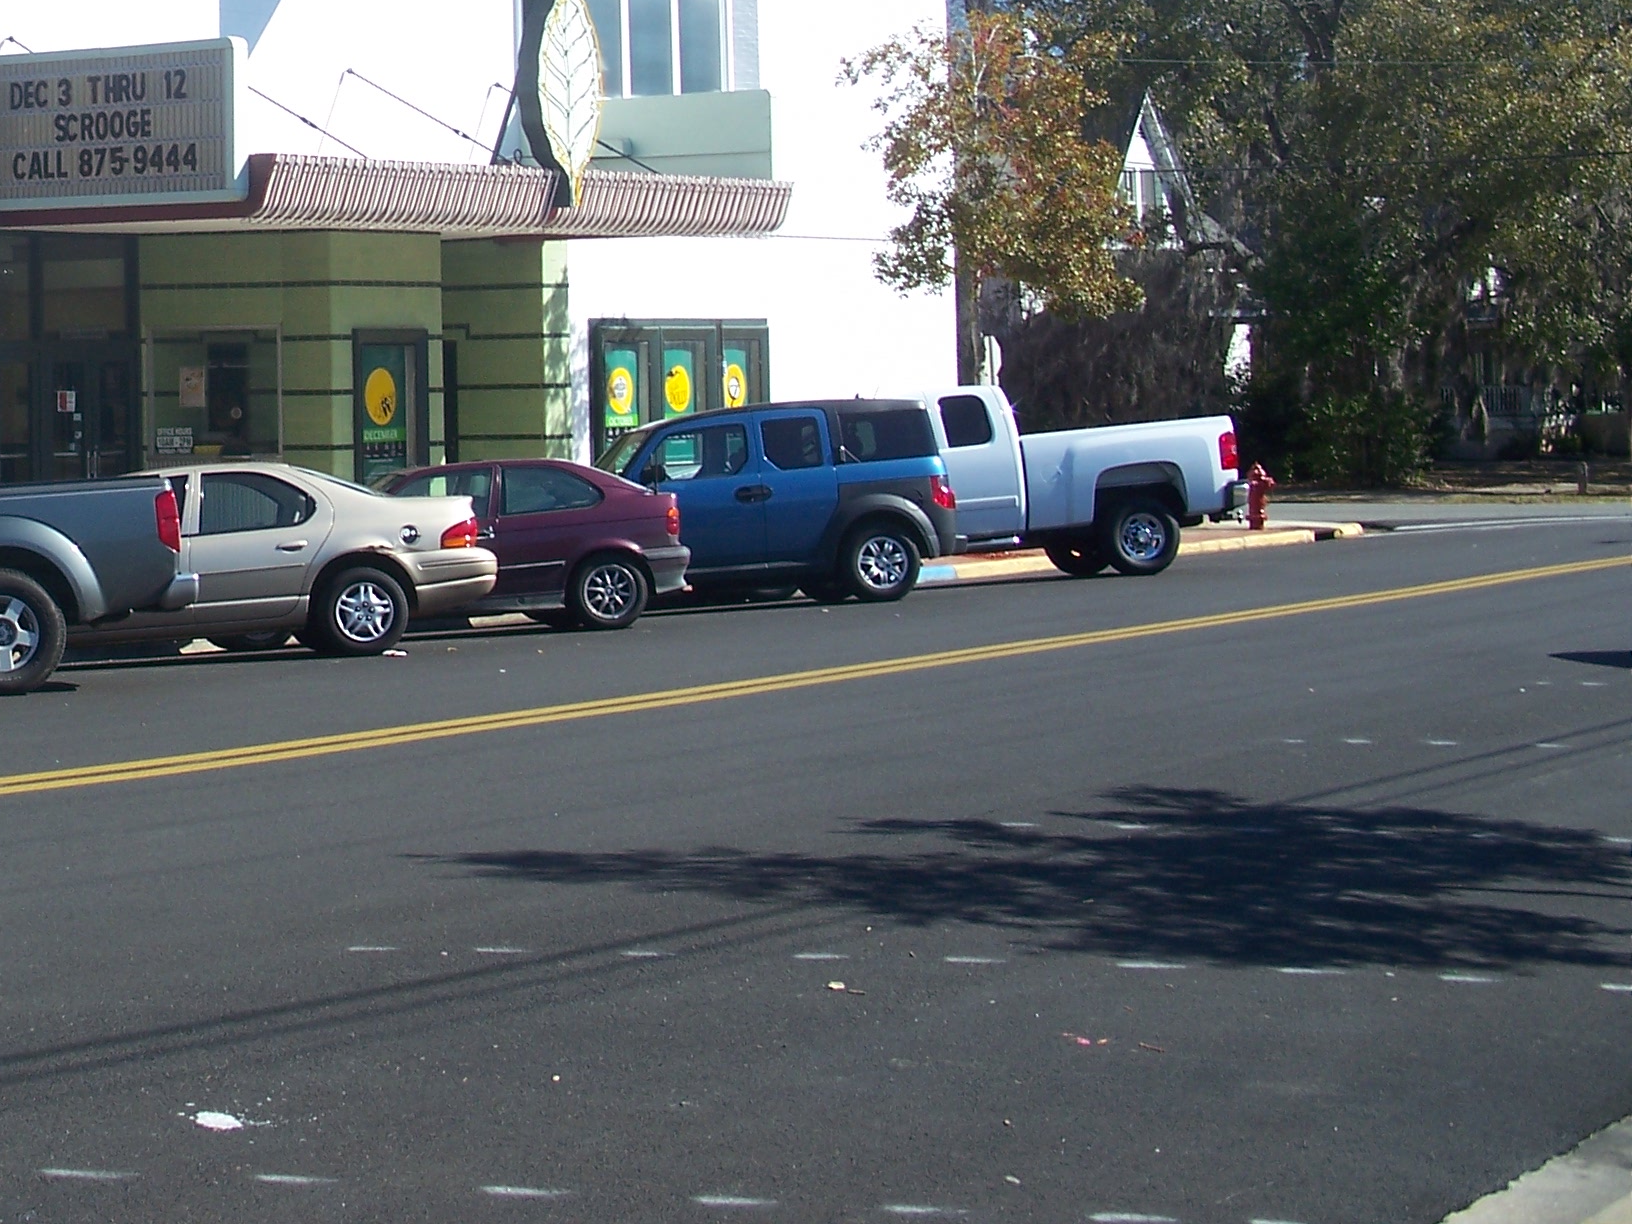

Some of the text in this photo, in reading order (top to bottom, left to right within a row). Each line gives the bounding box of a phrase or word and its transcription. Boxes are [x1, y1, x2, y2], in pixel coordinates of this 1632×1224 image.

[10, 69, 187, 110] DEC 3 THRU 12
[54, 109, 152, 142] SCROOGE
[13, 143, 197, 180] CALL 875-9444
